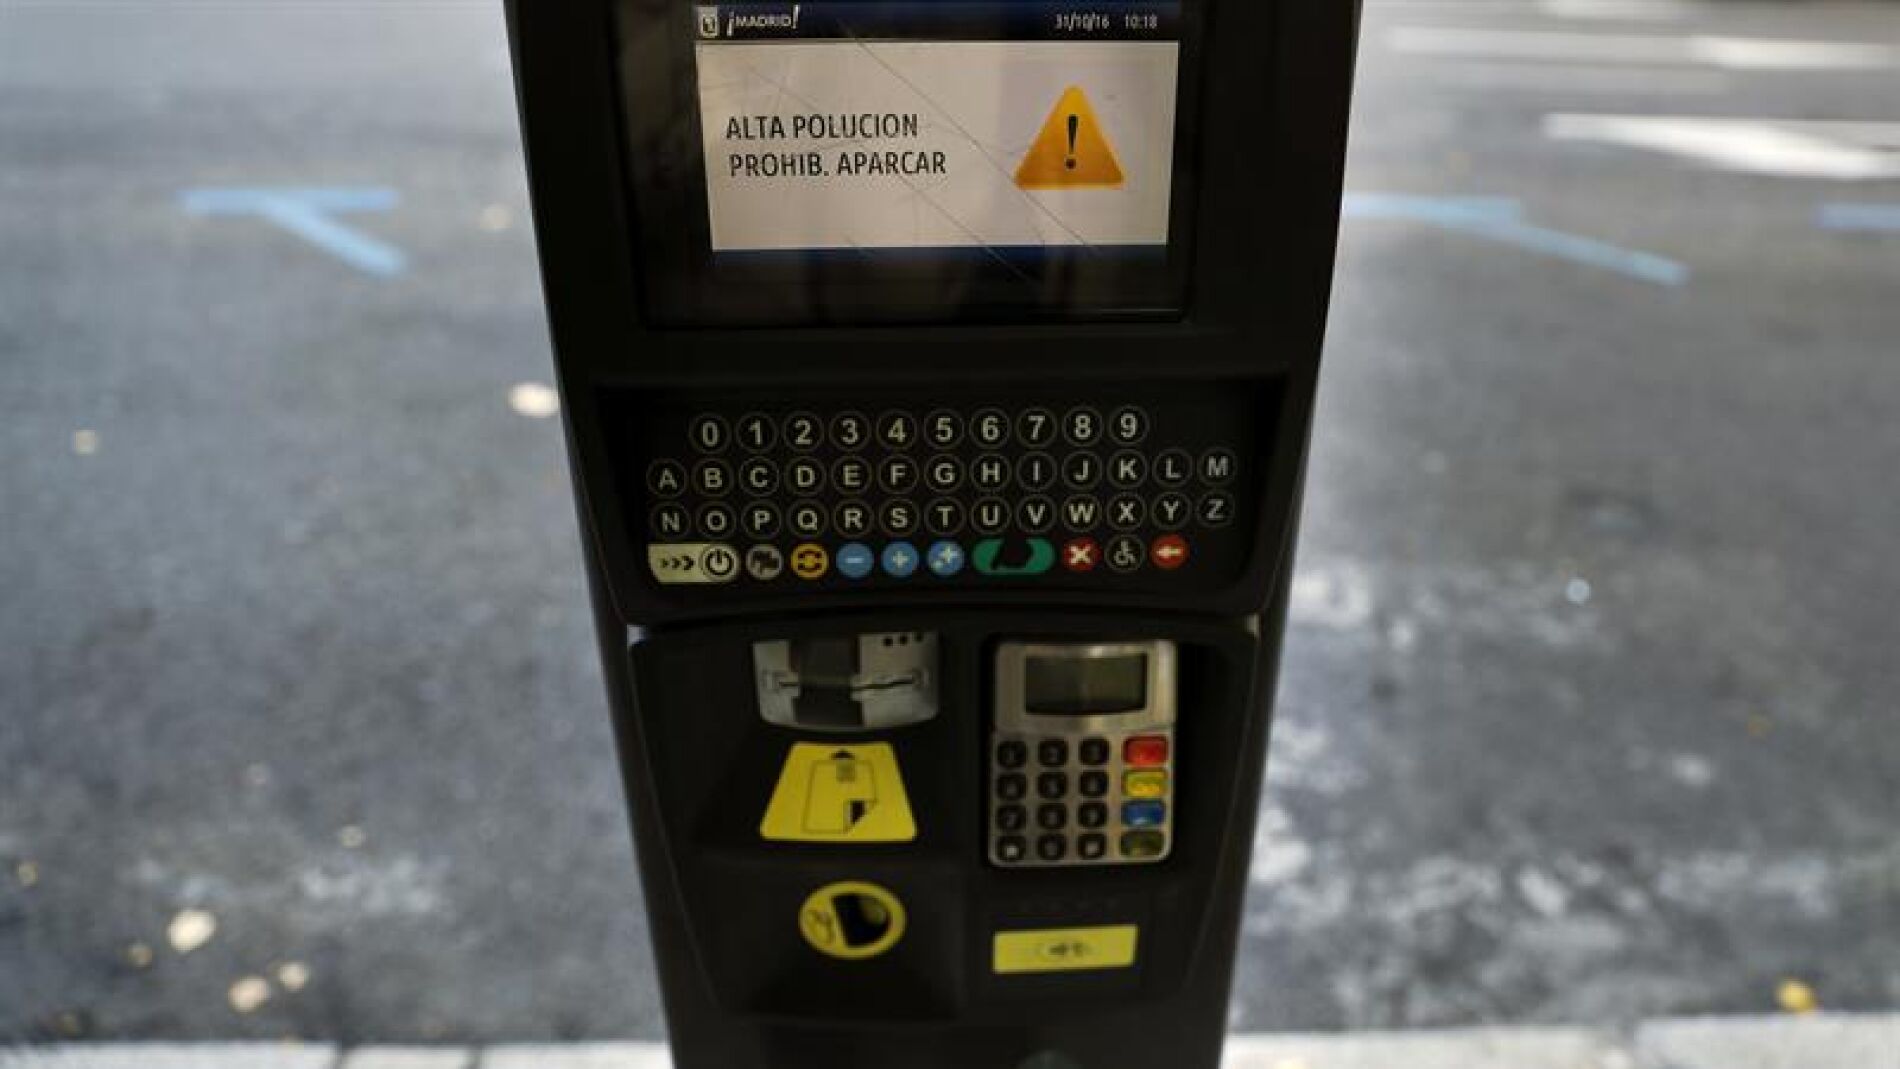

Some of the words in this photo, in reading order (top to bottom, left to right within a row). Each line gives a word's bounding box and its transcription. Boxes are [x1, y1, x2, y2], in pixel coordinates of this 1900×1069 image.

[1056, 12, 1109, 31] 31/10/16
[726, 115, 785, 140] ALTA
[793, 113, 917, 139] POLUCION
[729, 151, 829, 177] PROHIB.
[837, 151, 946, 175] APARCAR
[750, 421, 761, 445] 1
[795, 420, 811, 444] 2
[842, 419, 858, 444] 3
[888, 418, 906, 442] 4
[936, 417, 953, 442] 5
[982, 416, 999, 440] 6
[1028, 415, 1045, 440] 7
[1075, 415, 1091, 439] 8
[1121, 413, 1137, 438] 9
[659, 468, 677, 489] A
[704, 468, 722, 488] B
[750, 467, 768, 488] C
[797, 466, 815, 487] D
[843, 465, 860, 485] E
[891, 465, 905, 485] F
[935, 463, 955, 483] G
[982, 462, 1000, 482] H
[1033, 461, 1039, 481] I
[1075, 460, 1089, 481] J
[1120, 459, 1136, 479] K
[1166, 458, 1181, 478] L
[1208, 456, 1228, 476] M
[662, 513, 680, 531] N
[707, 511, 726, 531] O
[754, 510, 770, 530] P
[798, 510, 817, 530] Q
[845, 508, 862, 528] R
[891, 508, 908, 528] S
[937, 506, 953, 526] T
[982, 506, 999, 526] U
[1027, 505, 1045, 525] V
[1069, 503, 1094, 523] W
[1118, 502, 1134, 522] X
[1163, 501, 1179, 520] Y
[1207, 499, 1224, 520] Z
